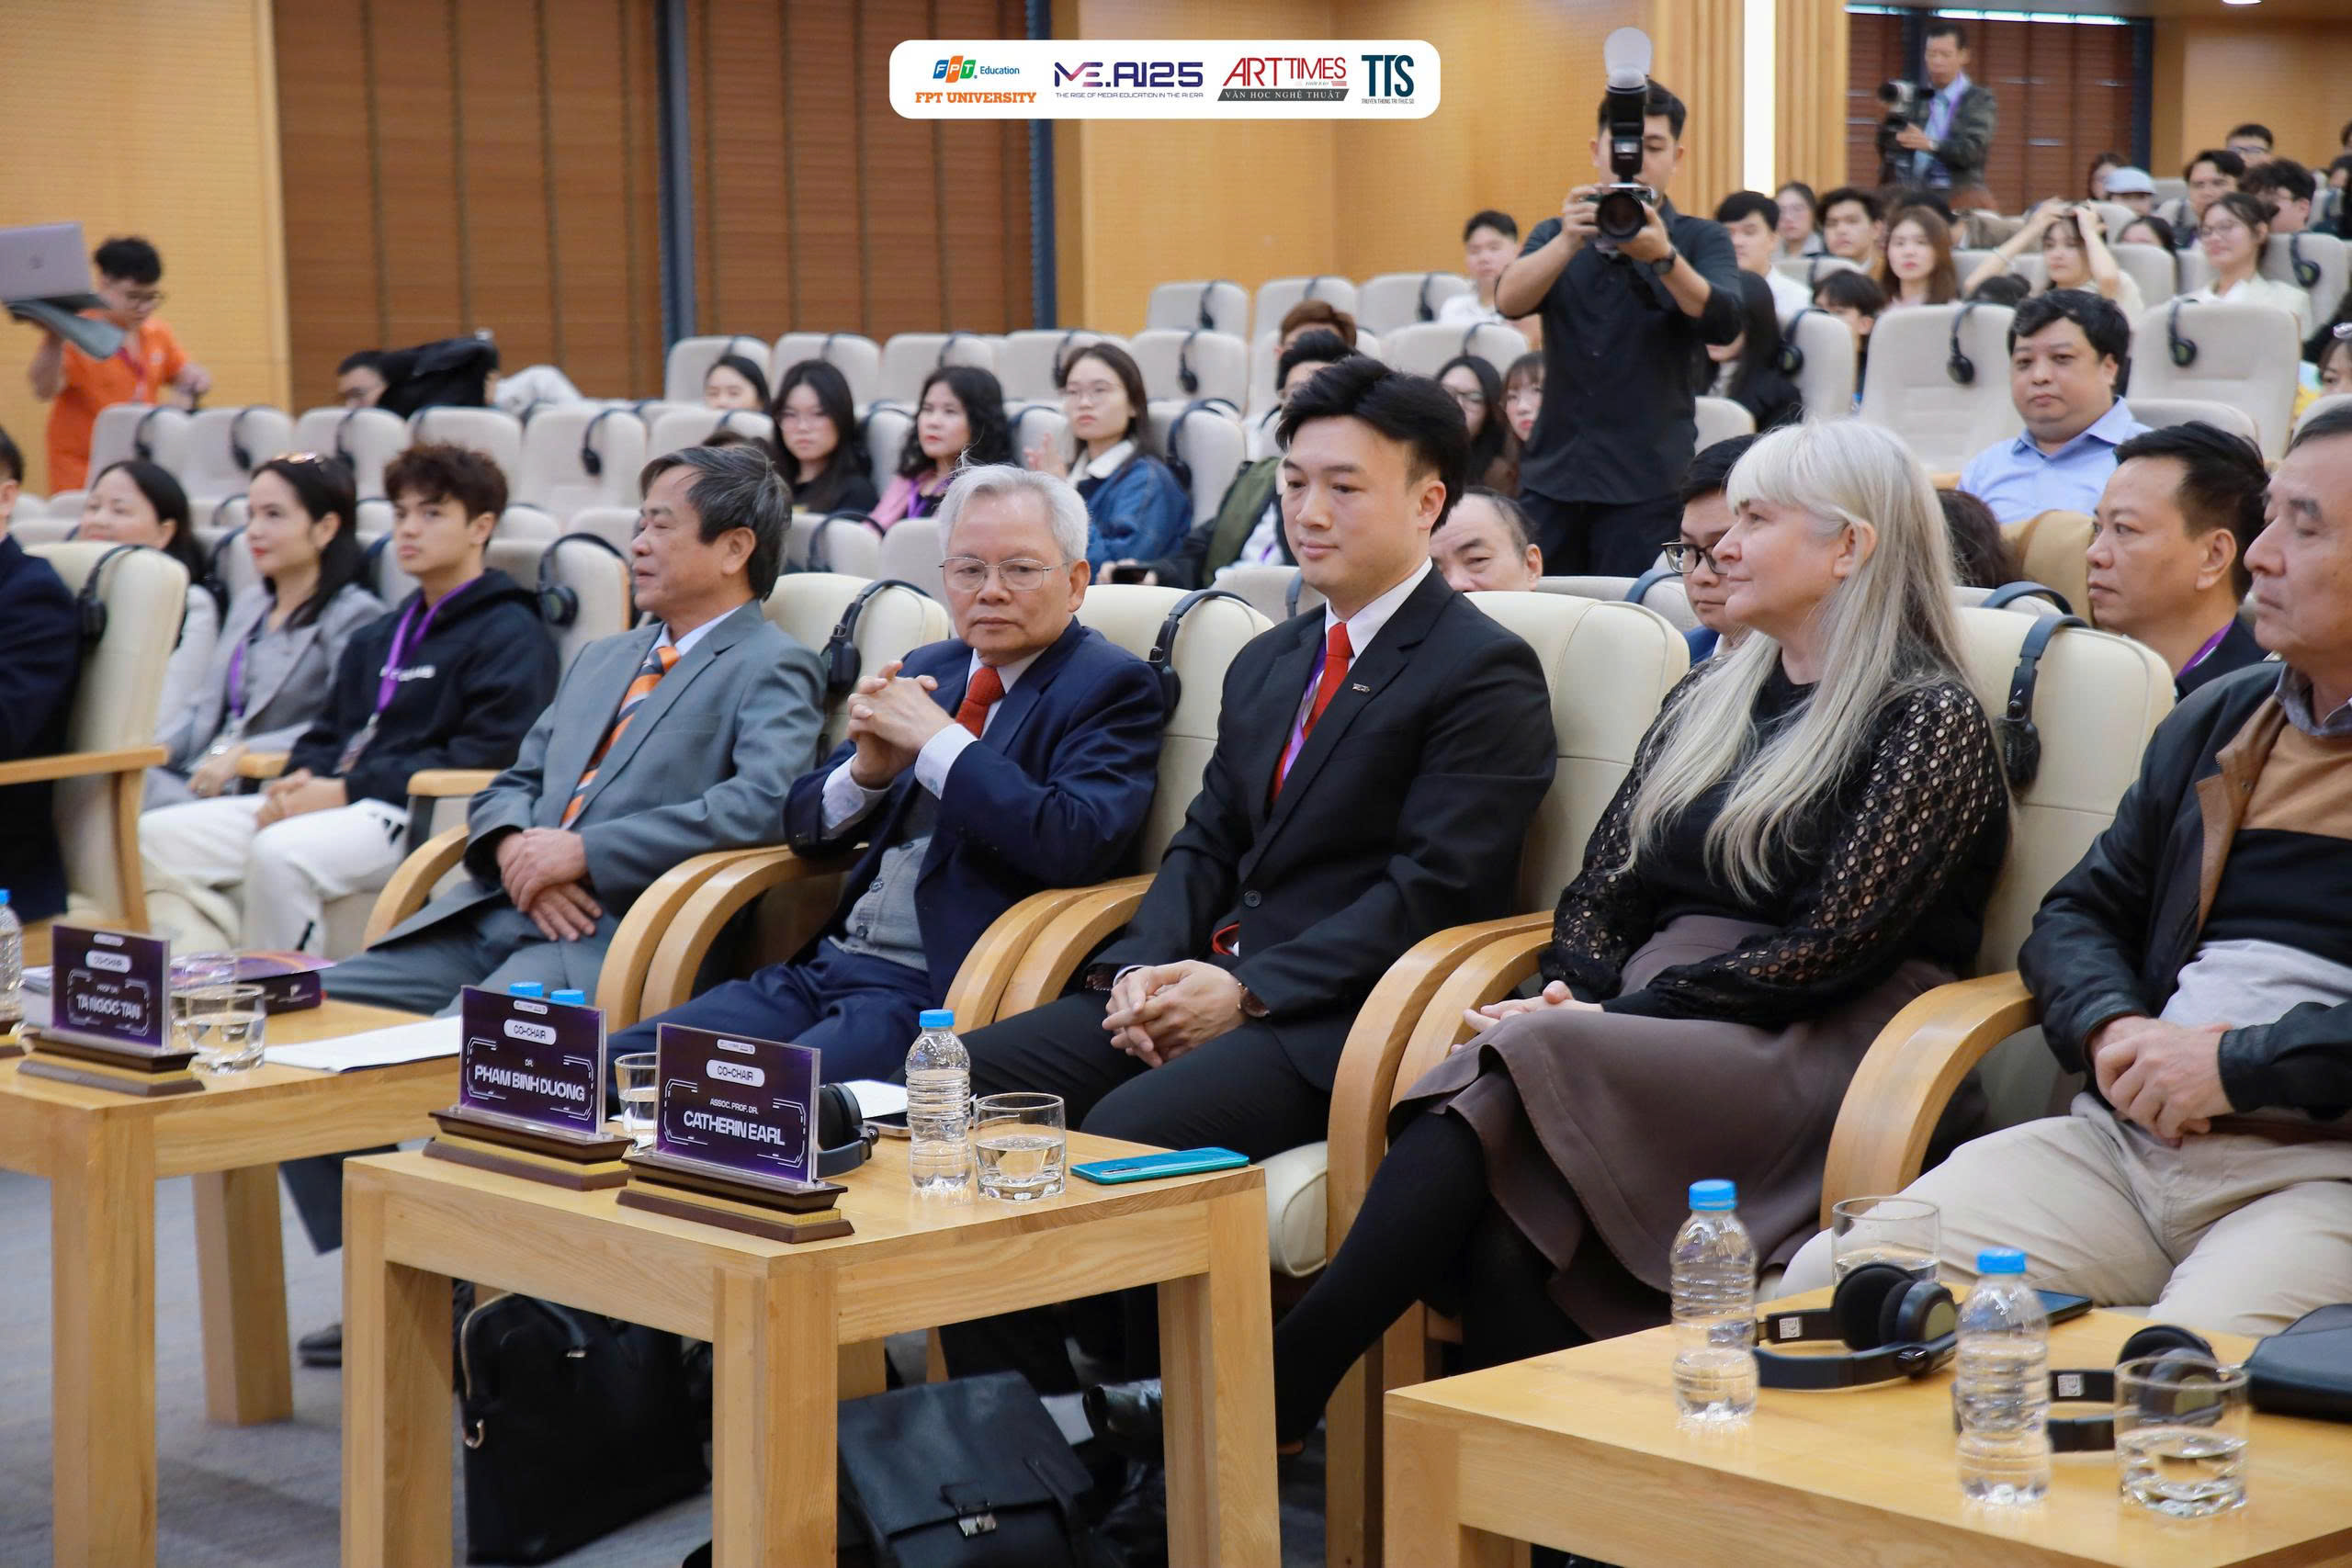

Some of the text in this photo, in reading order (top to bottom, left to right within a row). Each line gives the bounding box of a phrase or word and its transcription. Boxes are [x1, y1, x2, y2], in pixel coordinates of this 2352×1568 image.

[474, 1065, 585, 1101] PHAM BINH DUONG
[717, 1065, 753, 1081] CO-CHAIR
[683, 1110, 786, 1146] CATHERIN EARL
